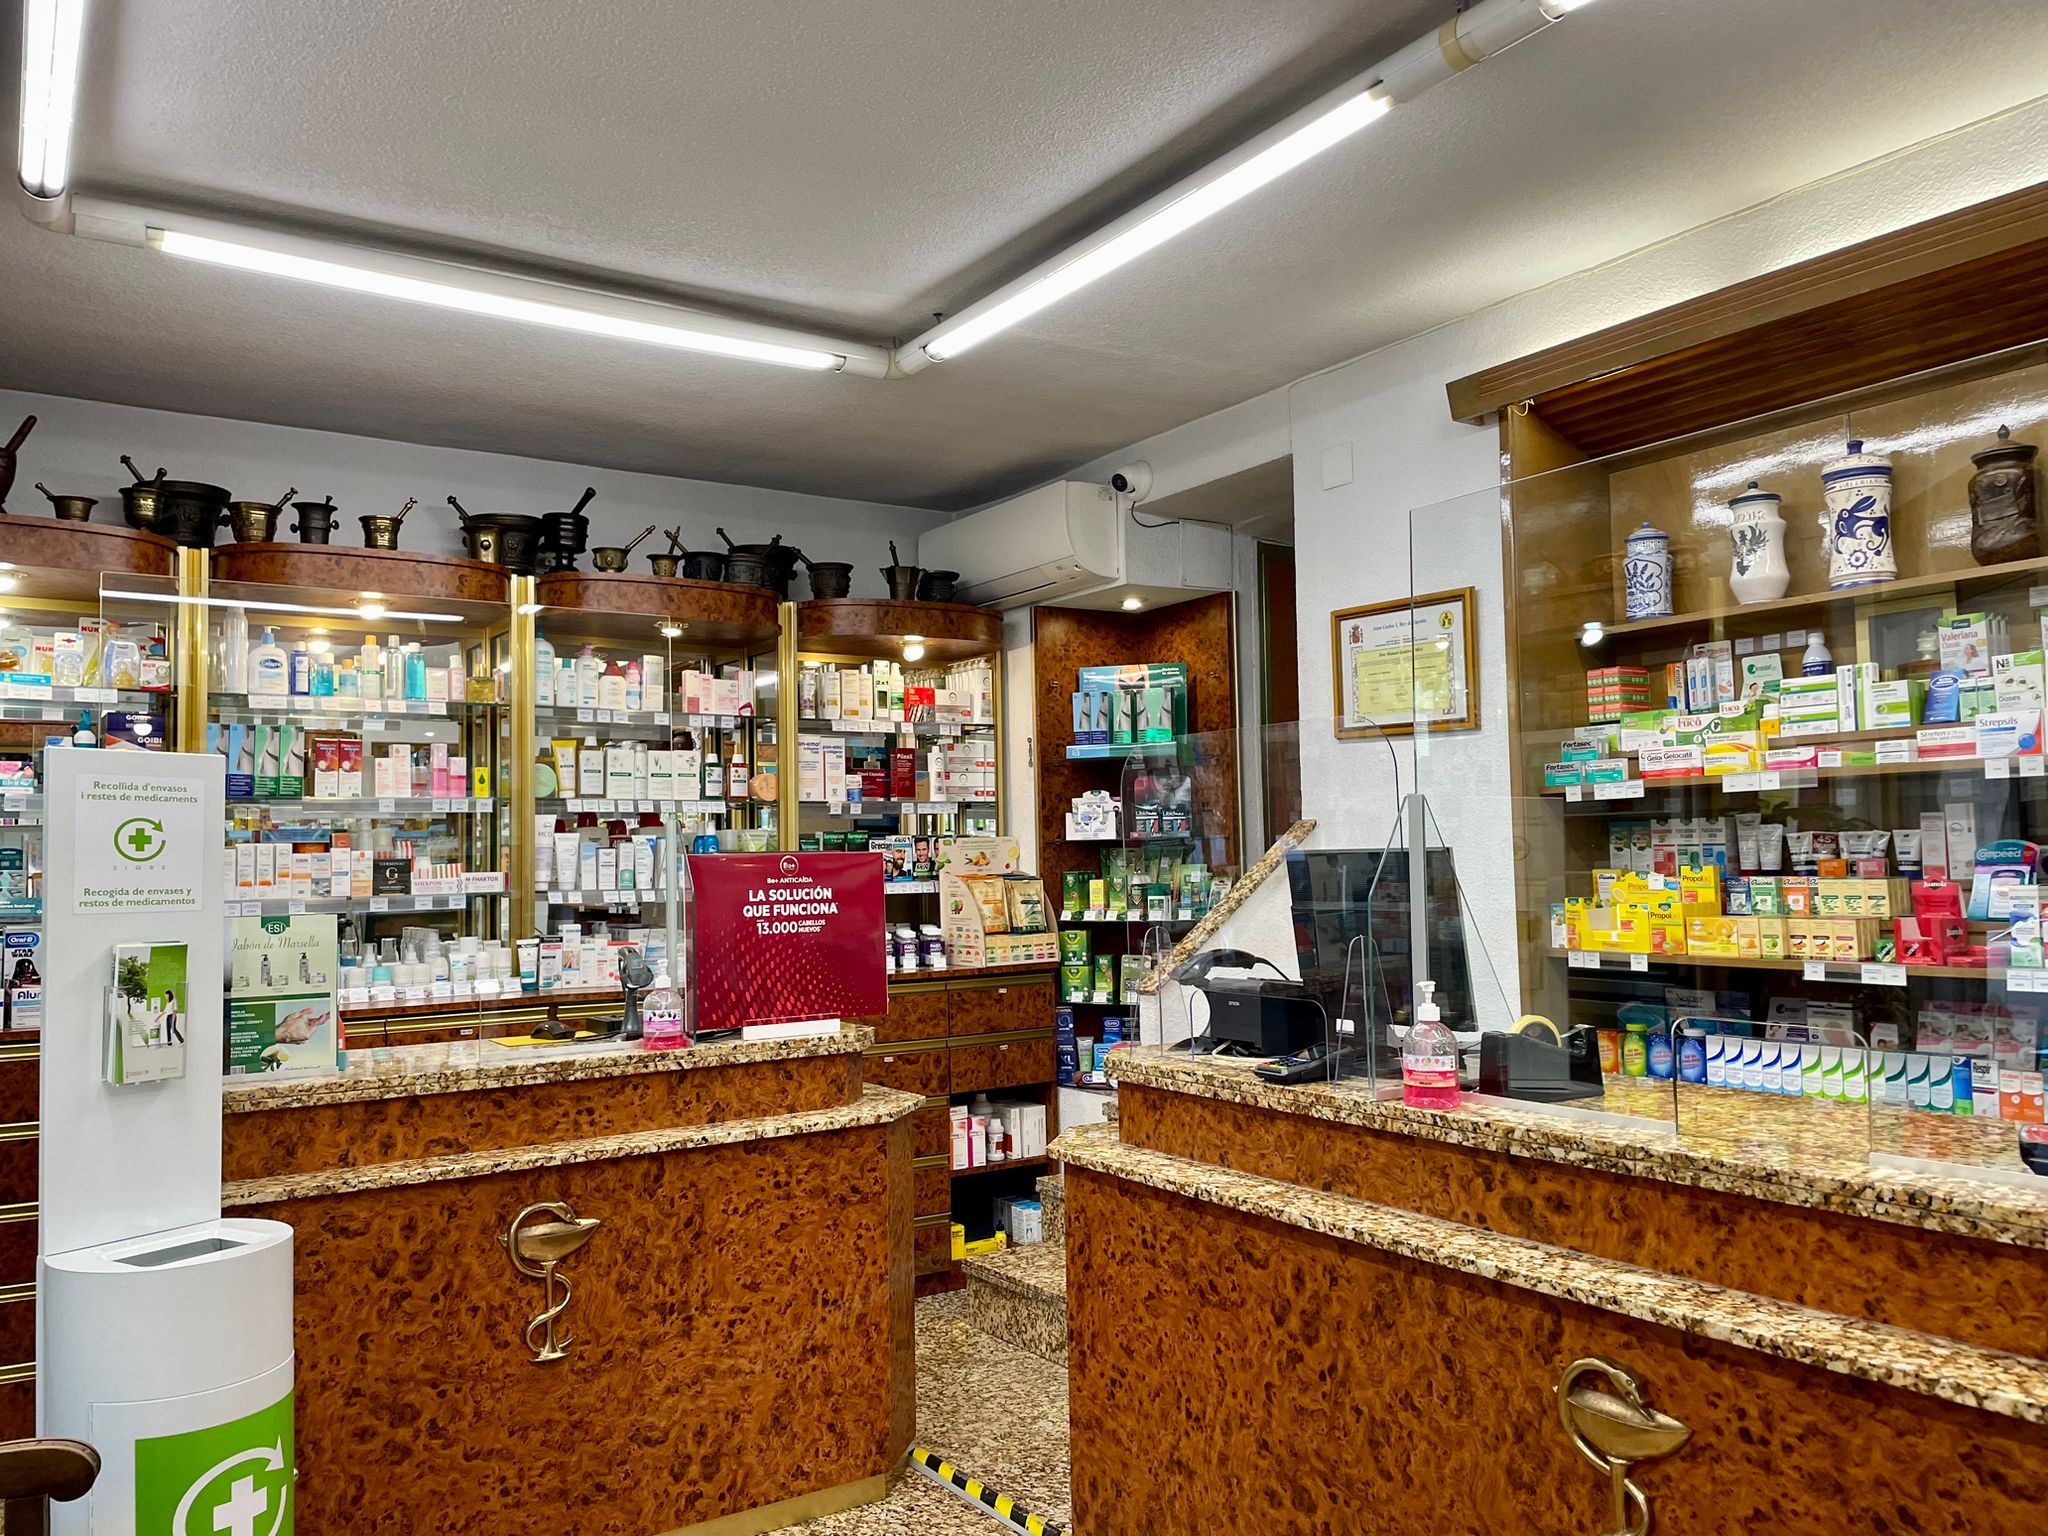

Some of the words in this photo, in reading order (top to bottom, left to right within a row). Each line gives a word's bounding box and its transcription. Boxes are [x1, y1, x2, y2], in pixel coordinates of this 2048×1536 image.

[1941, 631, 1978, 642] Valeriana
[1720, 704, 1740, 713] Fuca
[1979, 716, 2018, 729] Strepsils
[1663, 751, 1693, 760] Gelocatil
[1546, 763, 1575, 771] Fortasec
[93, 781, 139, 791] Recollida
[142, 783, 188, 793] d'envasos
[81, 791, 84, 799] i
[87, 793, 117, 801] restes
[119, 793, 132, 801] de
[134, 793, 198, 803] medicaments
[870, 841, 892, 850] Grecian
[779, 876, 813, 884] ANTICAÍDA
[84, 888, 130, 898] Recogida
[132, 887, 145, 896] de
[147, 887, 184, 896] envases
[186, 888, 192, 896] y
[1627, 883, 1648, 891] Propo
[748, 889, 766, 902] LA
[769, 885, 832, 901] SOLUCIÓN
[79, 900, 109, 908] restos
[111, 898, 124, 907] de
[126, 897, 196, 907] medicamentos
[743, 904, 771, 918] QUE
[756, 921, 798, 935] 13.000
[798, 919, 826, 927] CABELLOS
[268, 924, 283, 934] ESI
[231, 938, 261, 952] Jabón
[263, 937, 274, 950] de
[278, 935, 320, 950] Marsella
